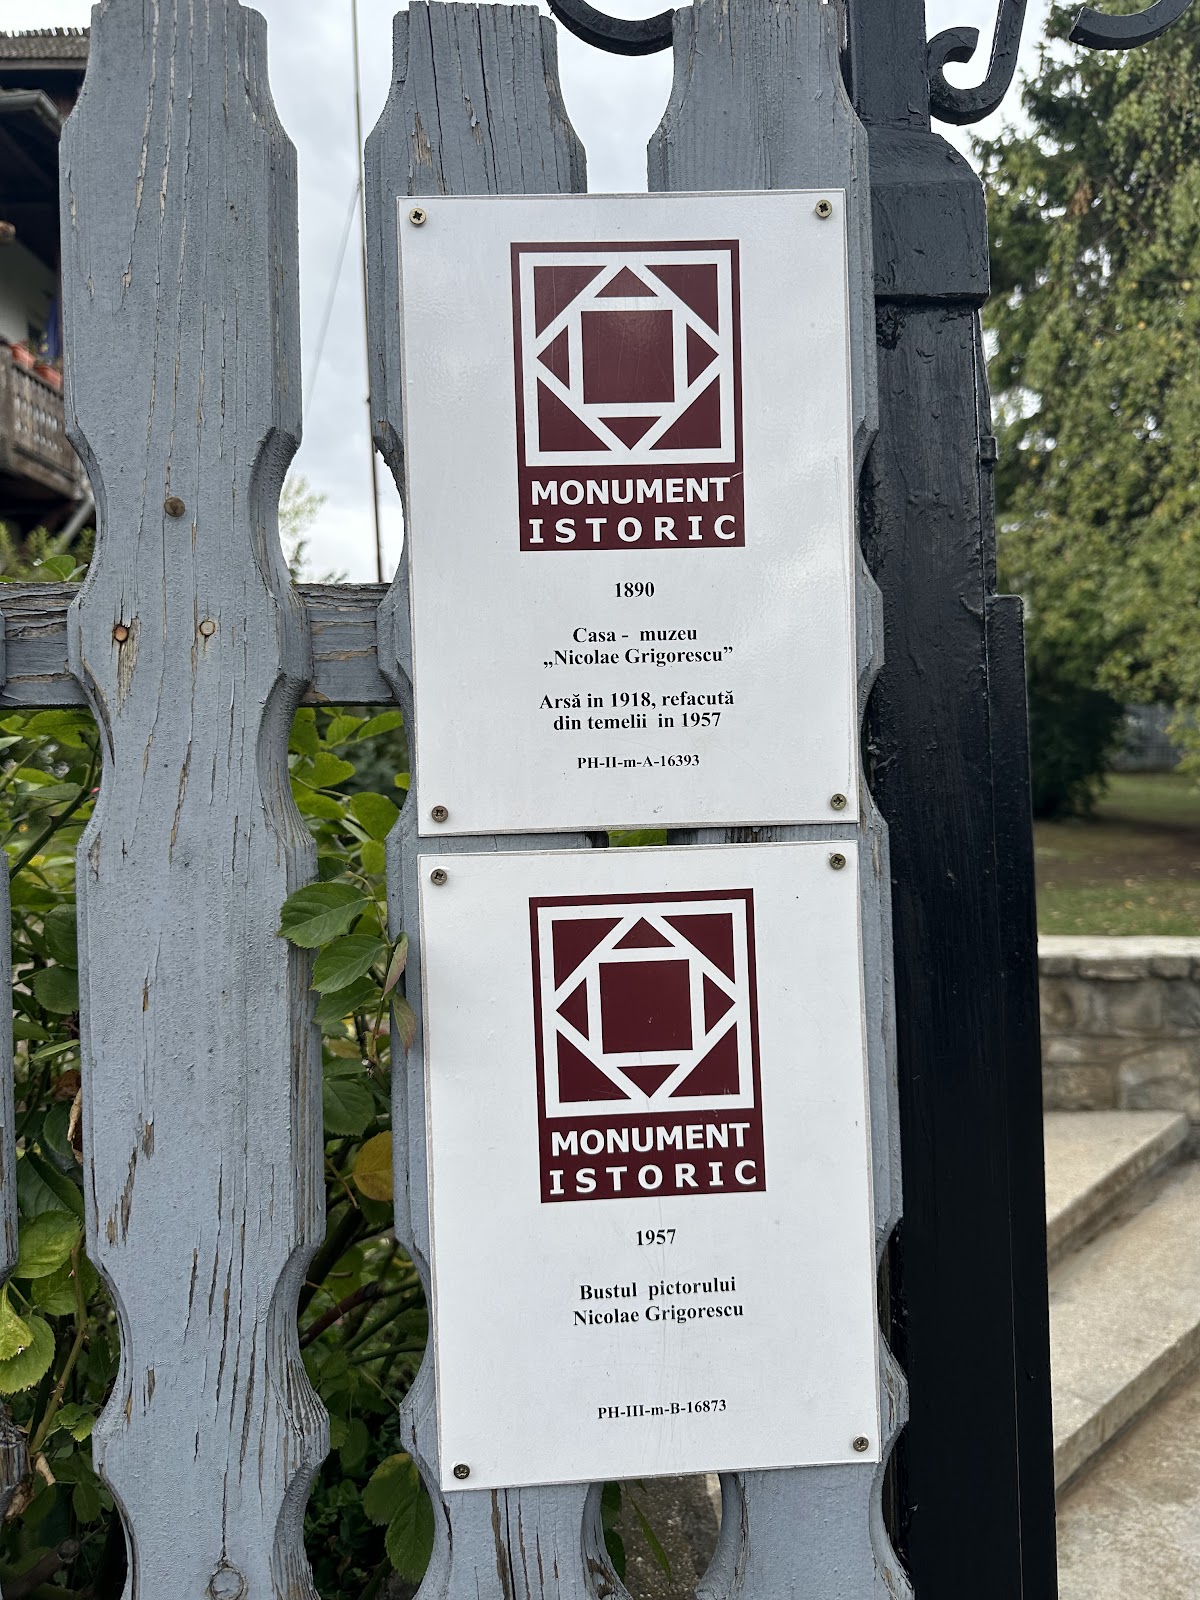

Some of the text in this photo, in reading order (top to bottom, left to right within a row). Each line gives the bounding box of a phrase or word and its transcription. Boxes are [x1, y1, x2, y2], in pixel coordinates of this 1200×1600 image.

[531, 477, 730, 505] MONUMENT
[529, 515, 736, 543] ISTORIC
[615, 581, 655, 598] 1890
[572, 627, 617, 643] Casa
[639, 629, 697, 642] muzeu
[538, 690, 735, 710] Arsă in 1918, refacută
[553, 711, 722, 731] din temelii in 1957
[577, 754, 700, 769] PH-II-m-A-16393
[552, 1123, 750, 1156] MONUMENT
[550, 1160, 757, 1195] ISTORIC
[636, 1228, 677, 1246] 1957
[580, 1275, 736, 1301] Bustul pictorului
[572, 1304, 744, 1326] Nicolae Grigorescu
[597, 1399, 727, 1420] PH-III-m-B-16873
